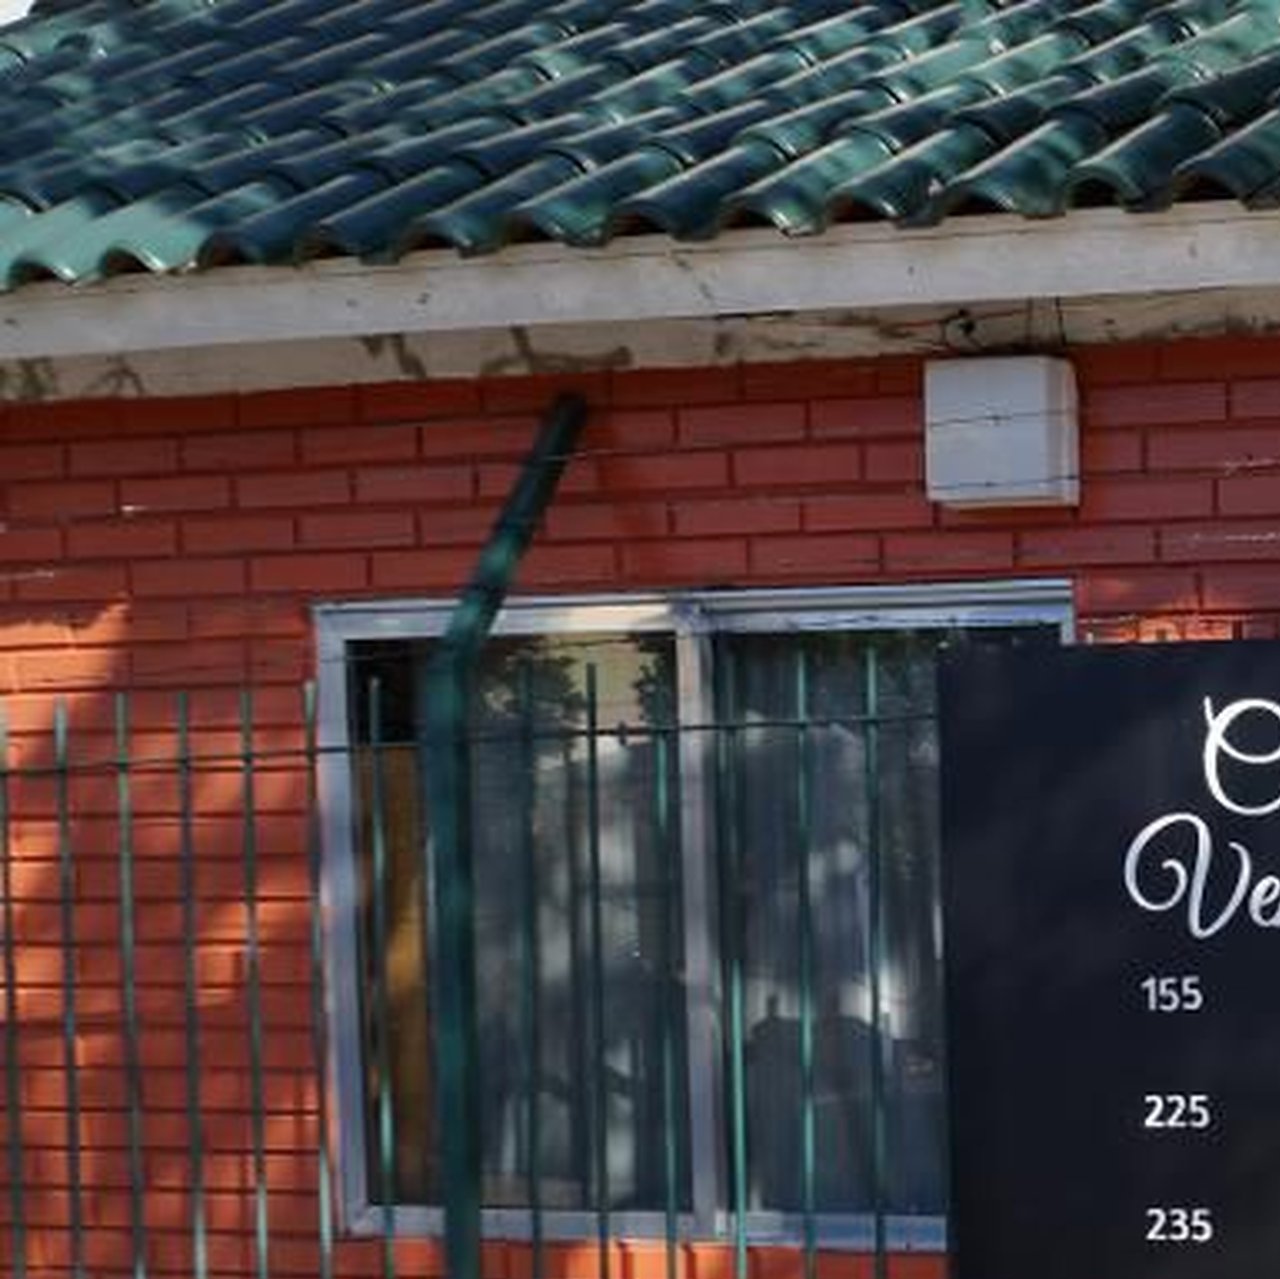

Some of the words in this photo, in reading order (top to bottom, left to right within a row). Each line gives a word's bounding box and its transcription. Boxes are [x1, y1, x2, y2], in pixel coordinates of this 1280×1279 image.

[1141, 975, 1203, 1012] 155
[1144, 1094, 1210, 1129] 225
[1145, 1207, 1213, 1243] 235
